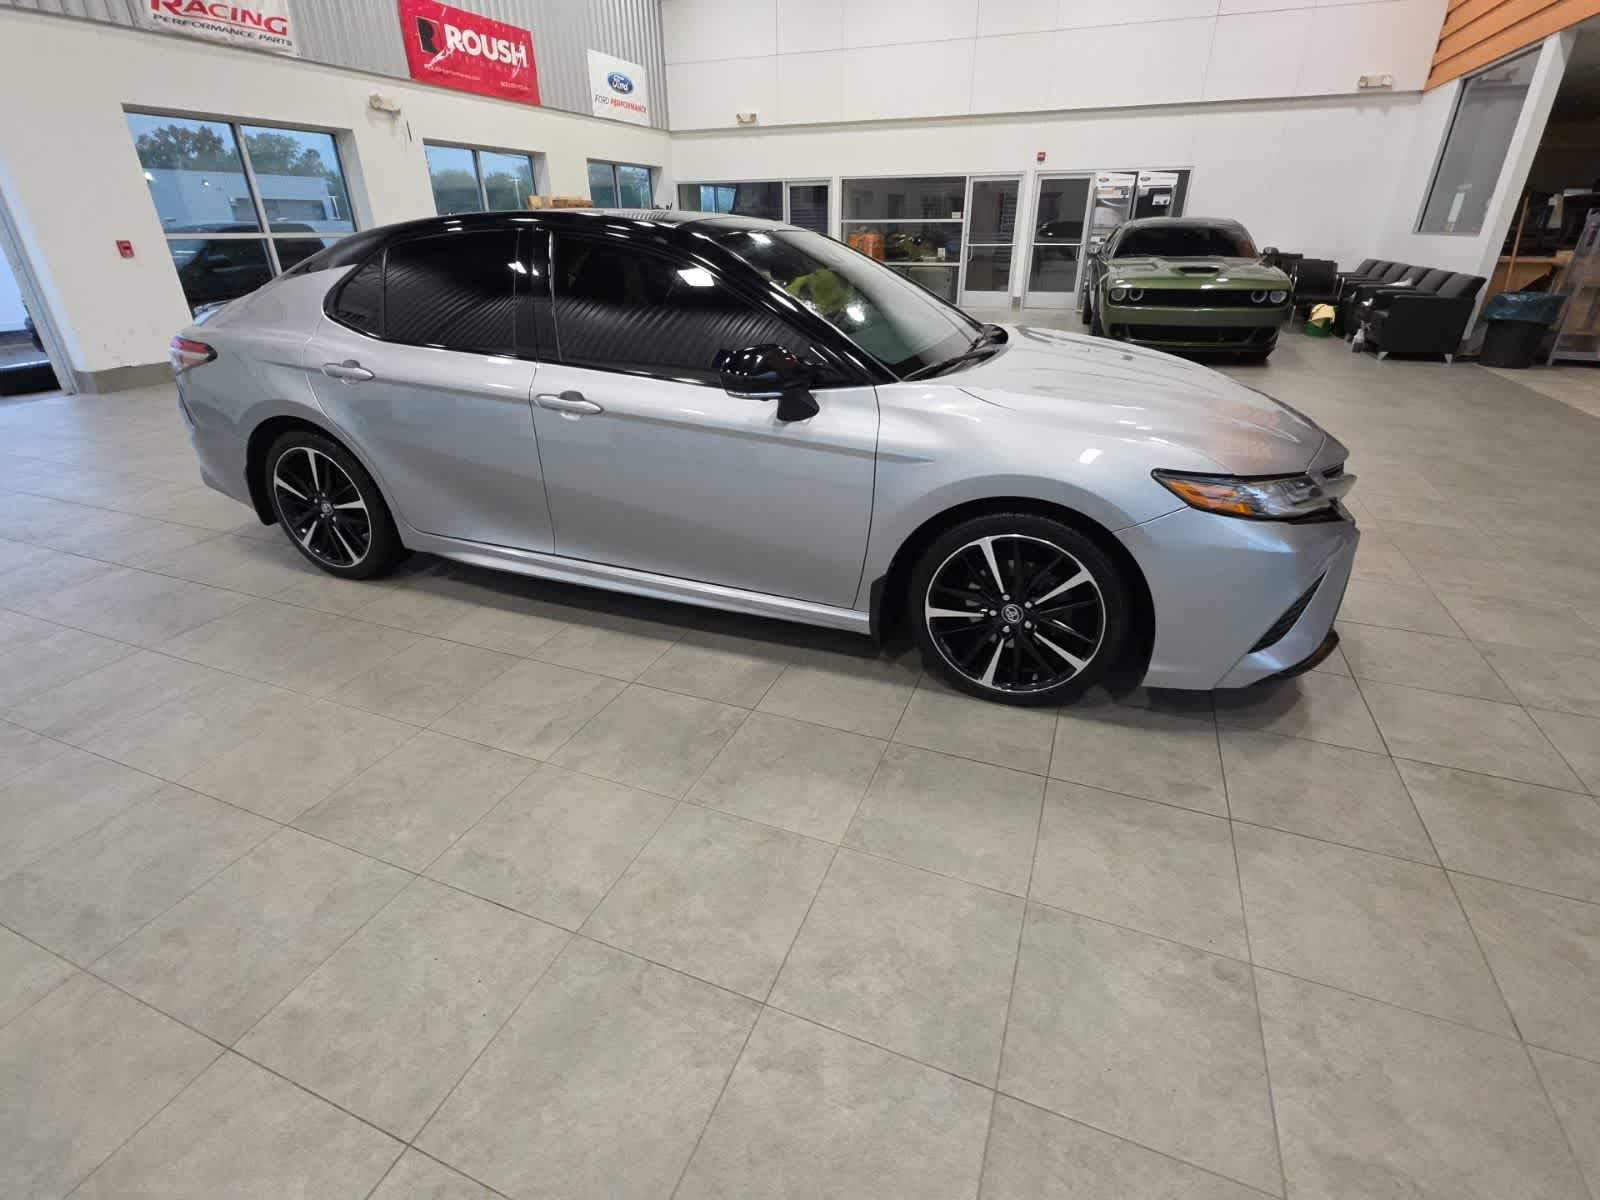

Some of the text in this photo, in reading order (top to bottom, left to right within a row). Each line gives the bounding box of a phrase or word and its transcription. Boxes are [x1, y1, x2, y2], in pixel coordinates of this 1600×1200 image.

[151, 0, 287, 35] RACING
[153, 14, 292, 46] PERFORMANCE PARTS
[443, 23, 528, 68] ROUSH
[612, 74, 629, 90] Ford
